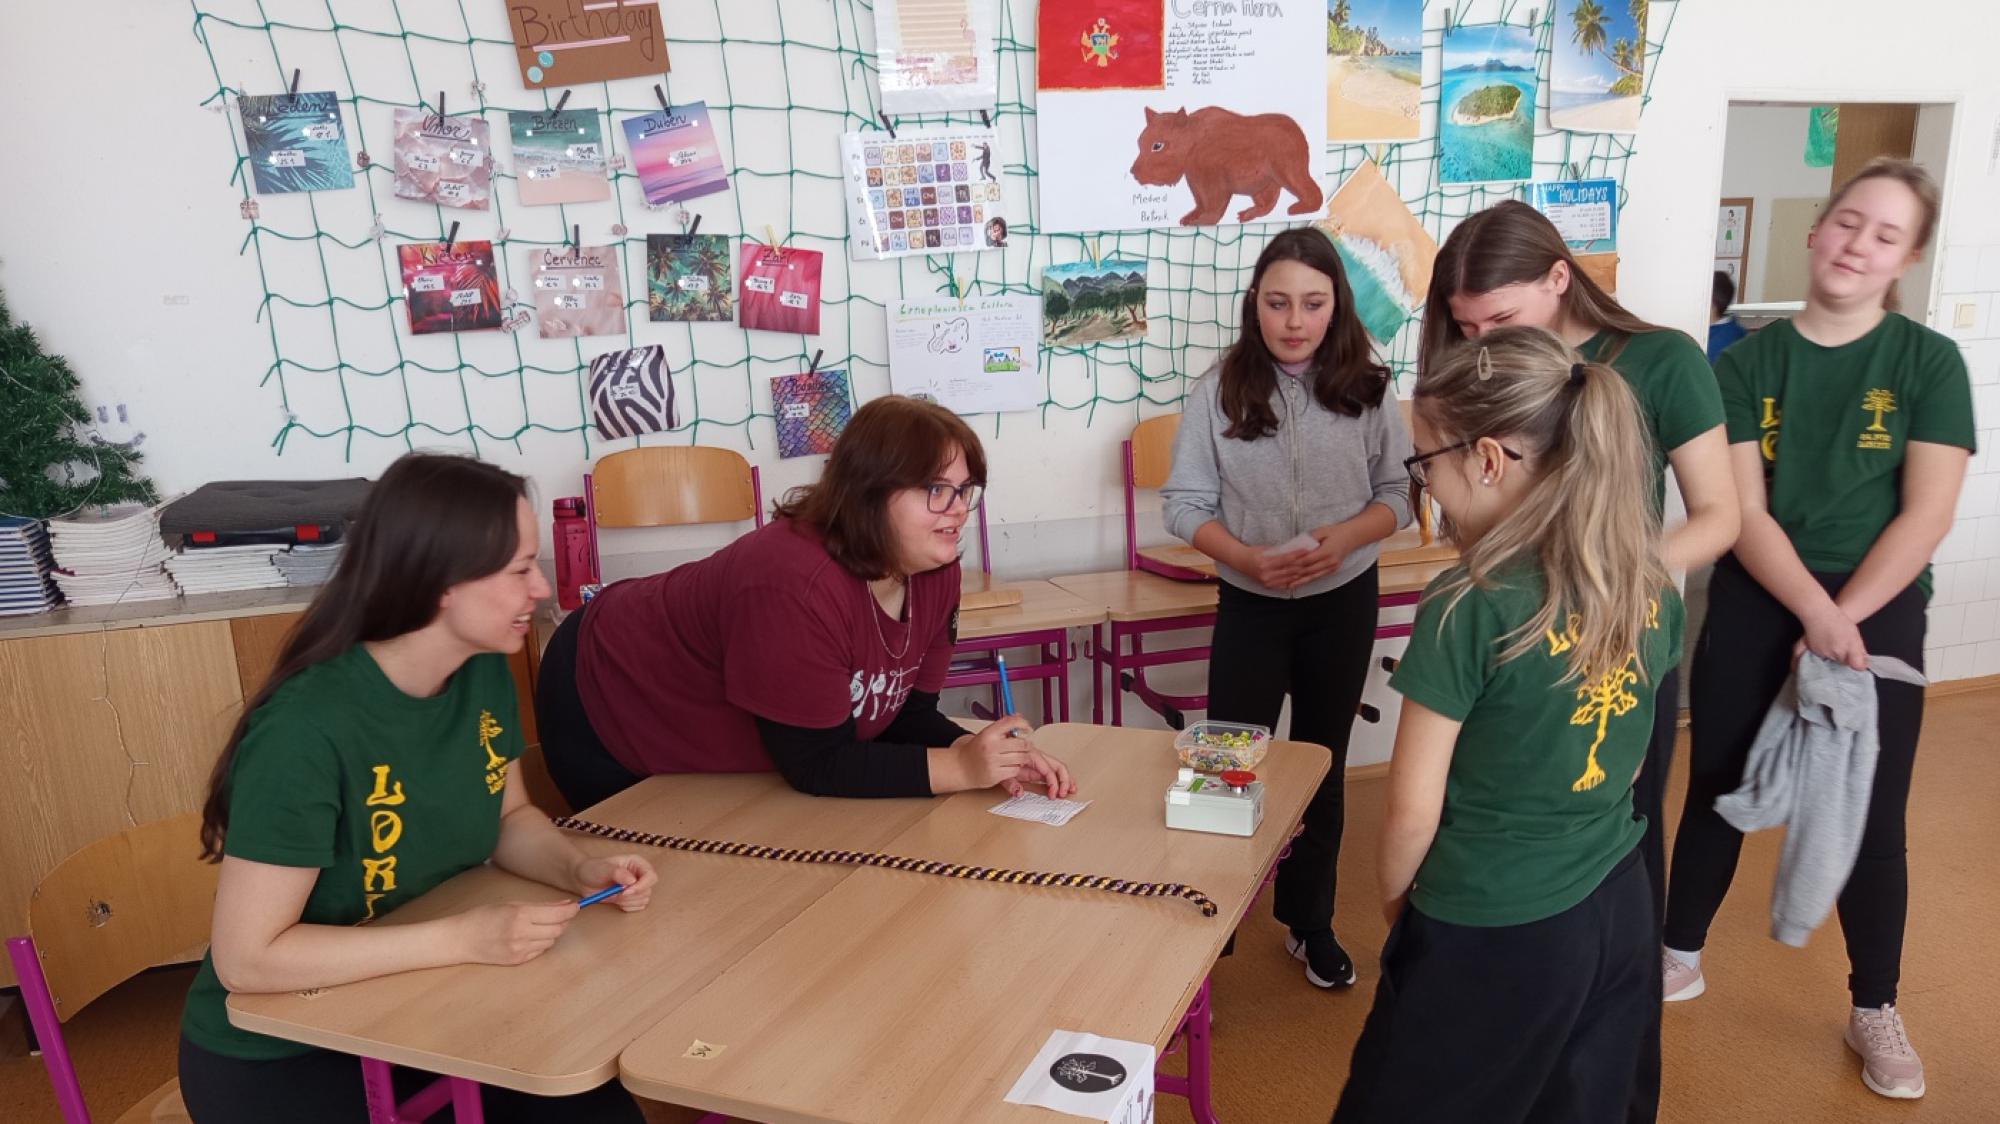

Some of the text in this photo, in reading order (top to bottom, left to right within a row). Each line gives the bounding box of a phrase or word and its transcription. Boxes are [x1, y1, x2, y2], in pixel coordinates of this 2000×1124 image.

[511, 0, 656, 62] Birthday
[643, 114, 687, 132] Duben
[1559, 186, 1608, 203] HOLIDAYS
[543, 248, 602, 266] Červenec
